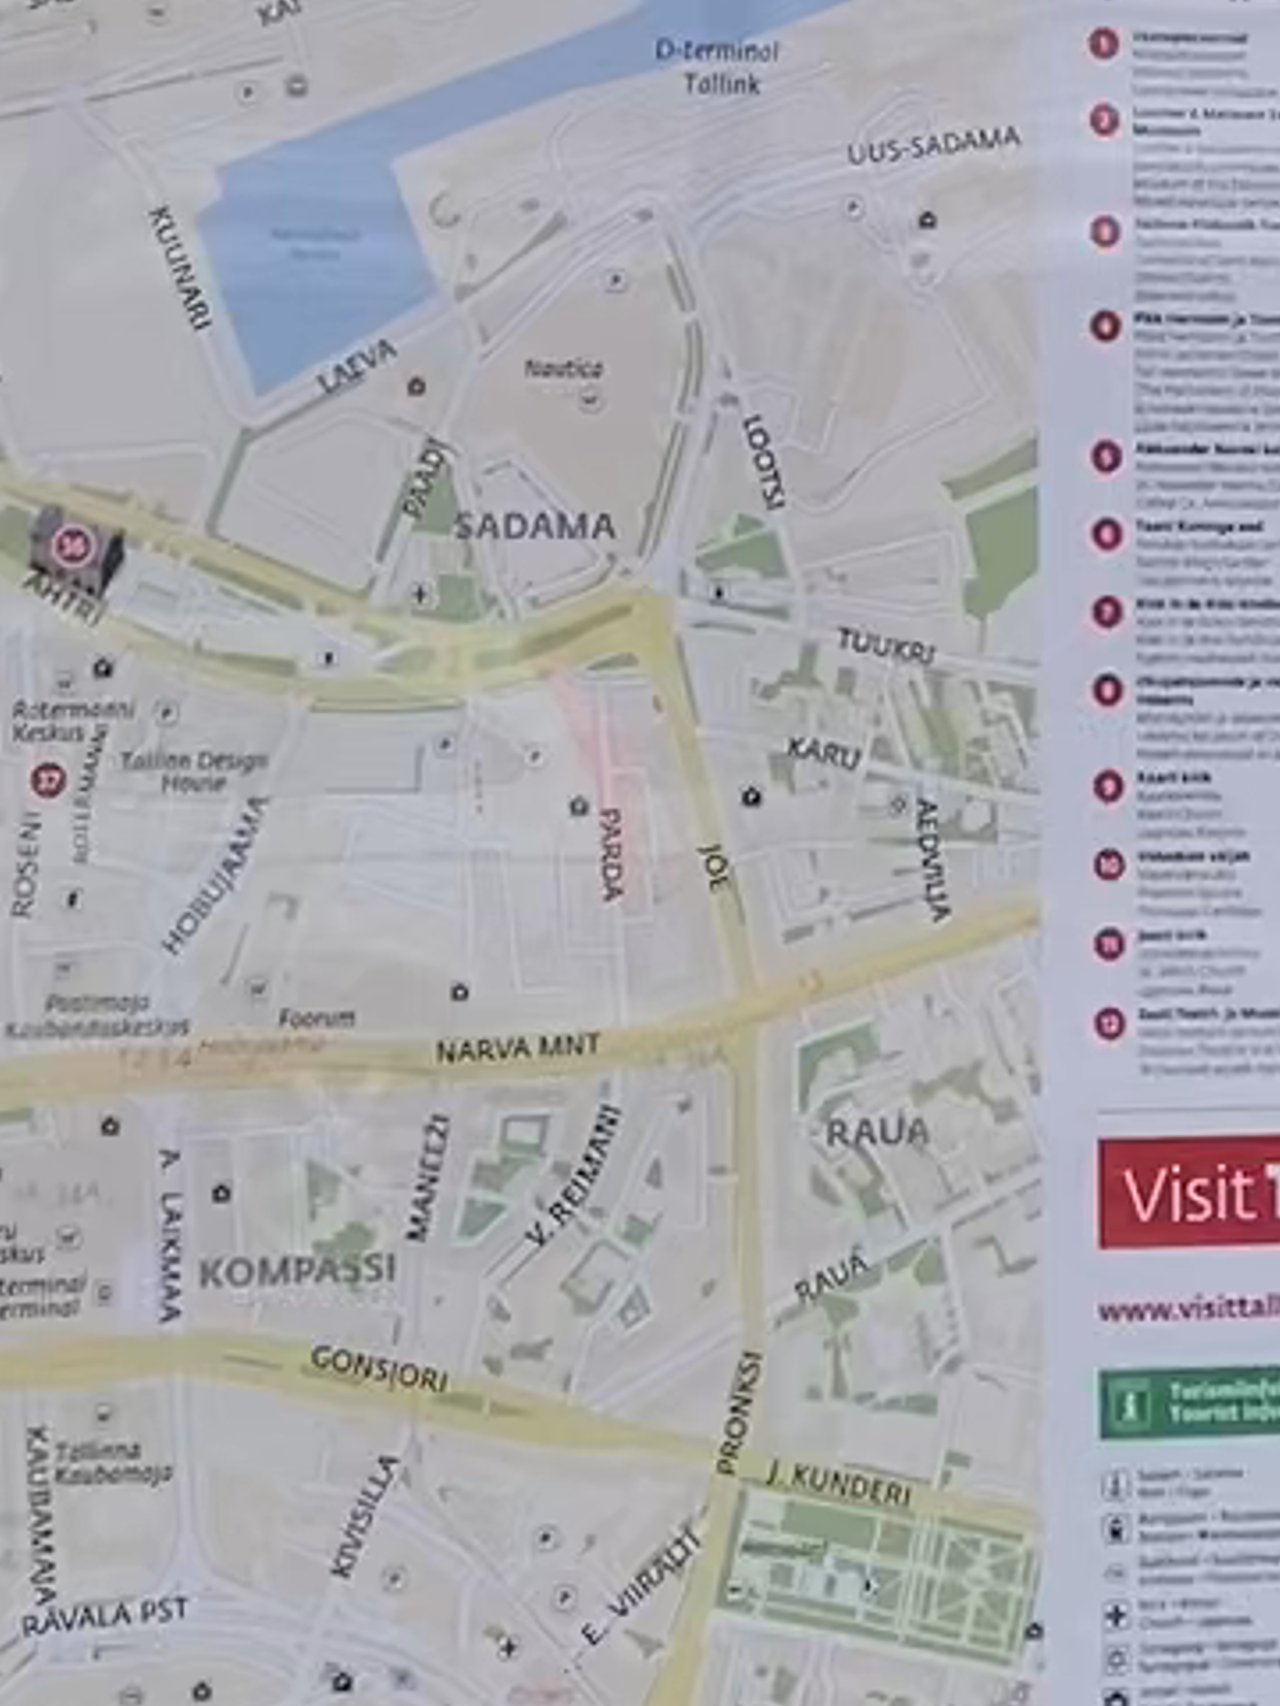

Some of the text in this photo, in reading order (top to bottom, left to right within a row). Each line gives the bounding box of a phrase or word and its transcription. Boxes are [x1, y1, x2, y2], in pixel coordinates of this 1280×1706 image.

[655, 38, 780, 62] D-terminal
[684, 72, 761, 96] Tallink
[847, 125, 1021, 166] UUS-SADAMA
[149, 204, 213, 332] KUUNARI
[317, 337, 398, 394] LAEVA
[403, 437, 445, 520] PAADI
[742, 414, 786, 513] LOOTSI
[455, 512, 616, 541] SADAMA
[23, 574, 108, 627] AHTRI
[836, 627, 937, 667] TUUKRI
[13, 723, 85, 743] Keskus
[787, 736, 863, 771] KARU
[162, 774, 227, 793] House
[11, 810, 42, 920] ROSENI
[162, 792, 271, 957] HOBUJAAMA
[600, 807, 624, 904] PARDA
[916, 795, 952, 924] AEDVILJA
[278, 1007, 356, 1029] Foorum
[437, 1031, 601, 1064] NARVA MNT
[825, 1113, 930, 1147] RAUA
[549, 1104, 623, 1227] REIMANI
[1123, 1163, 1257, 1223] Visit
[199, 1252, 397, 1288] KOMPASSI
[794, 1242, 871, 1304] RAUA
[310, 1345, 449, 1393] GONSIORI
[715, 1350, 764, 1476] PRONKSI
[54, 1442, 142, 1462] Tallinna
[791, 1462, 912, 1508] KUNDERI
[25, 1425, 57, 1607] KAUBAMAJA
[330, 1454, 401, 1580] KIVISILLA
[141, 1597, 190, 1622] PST
